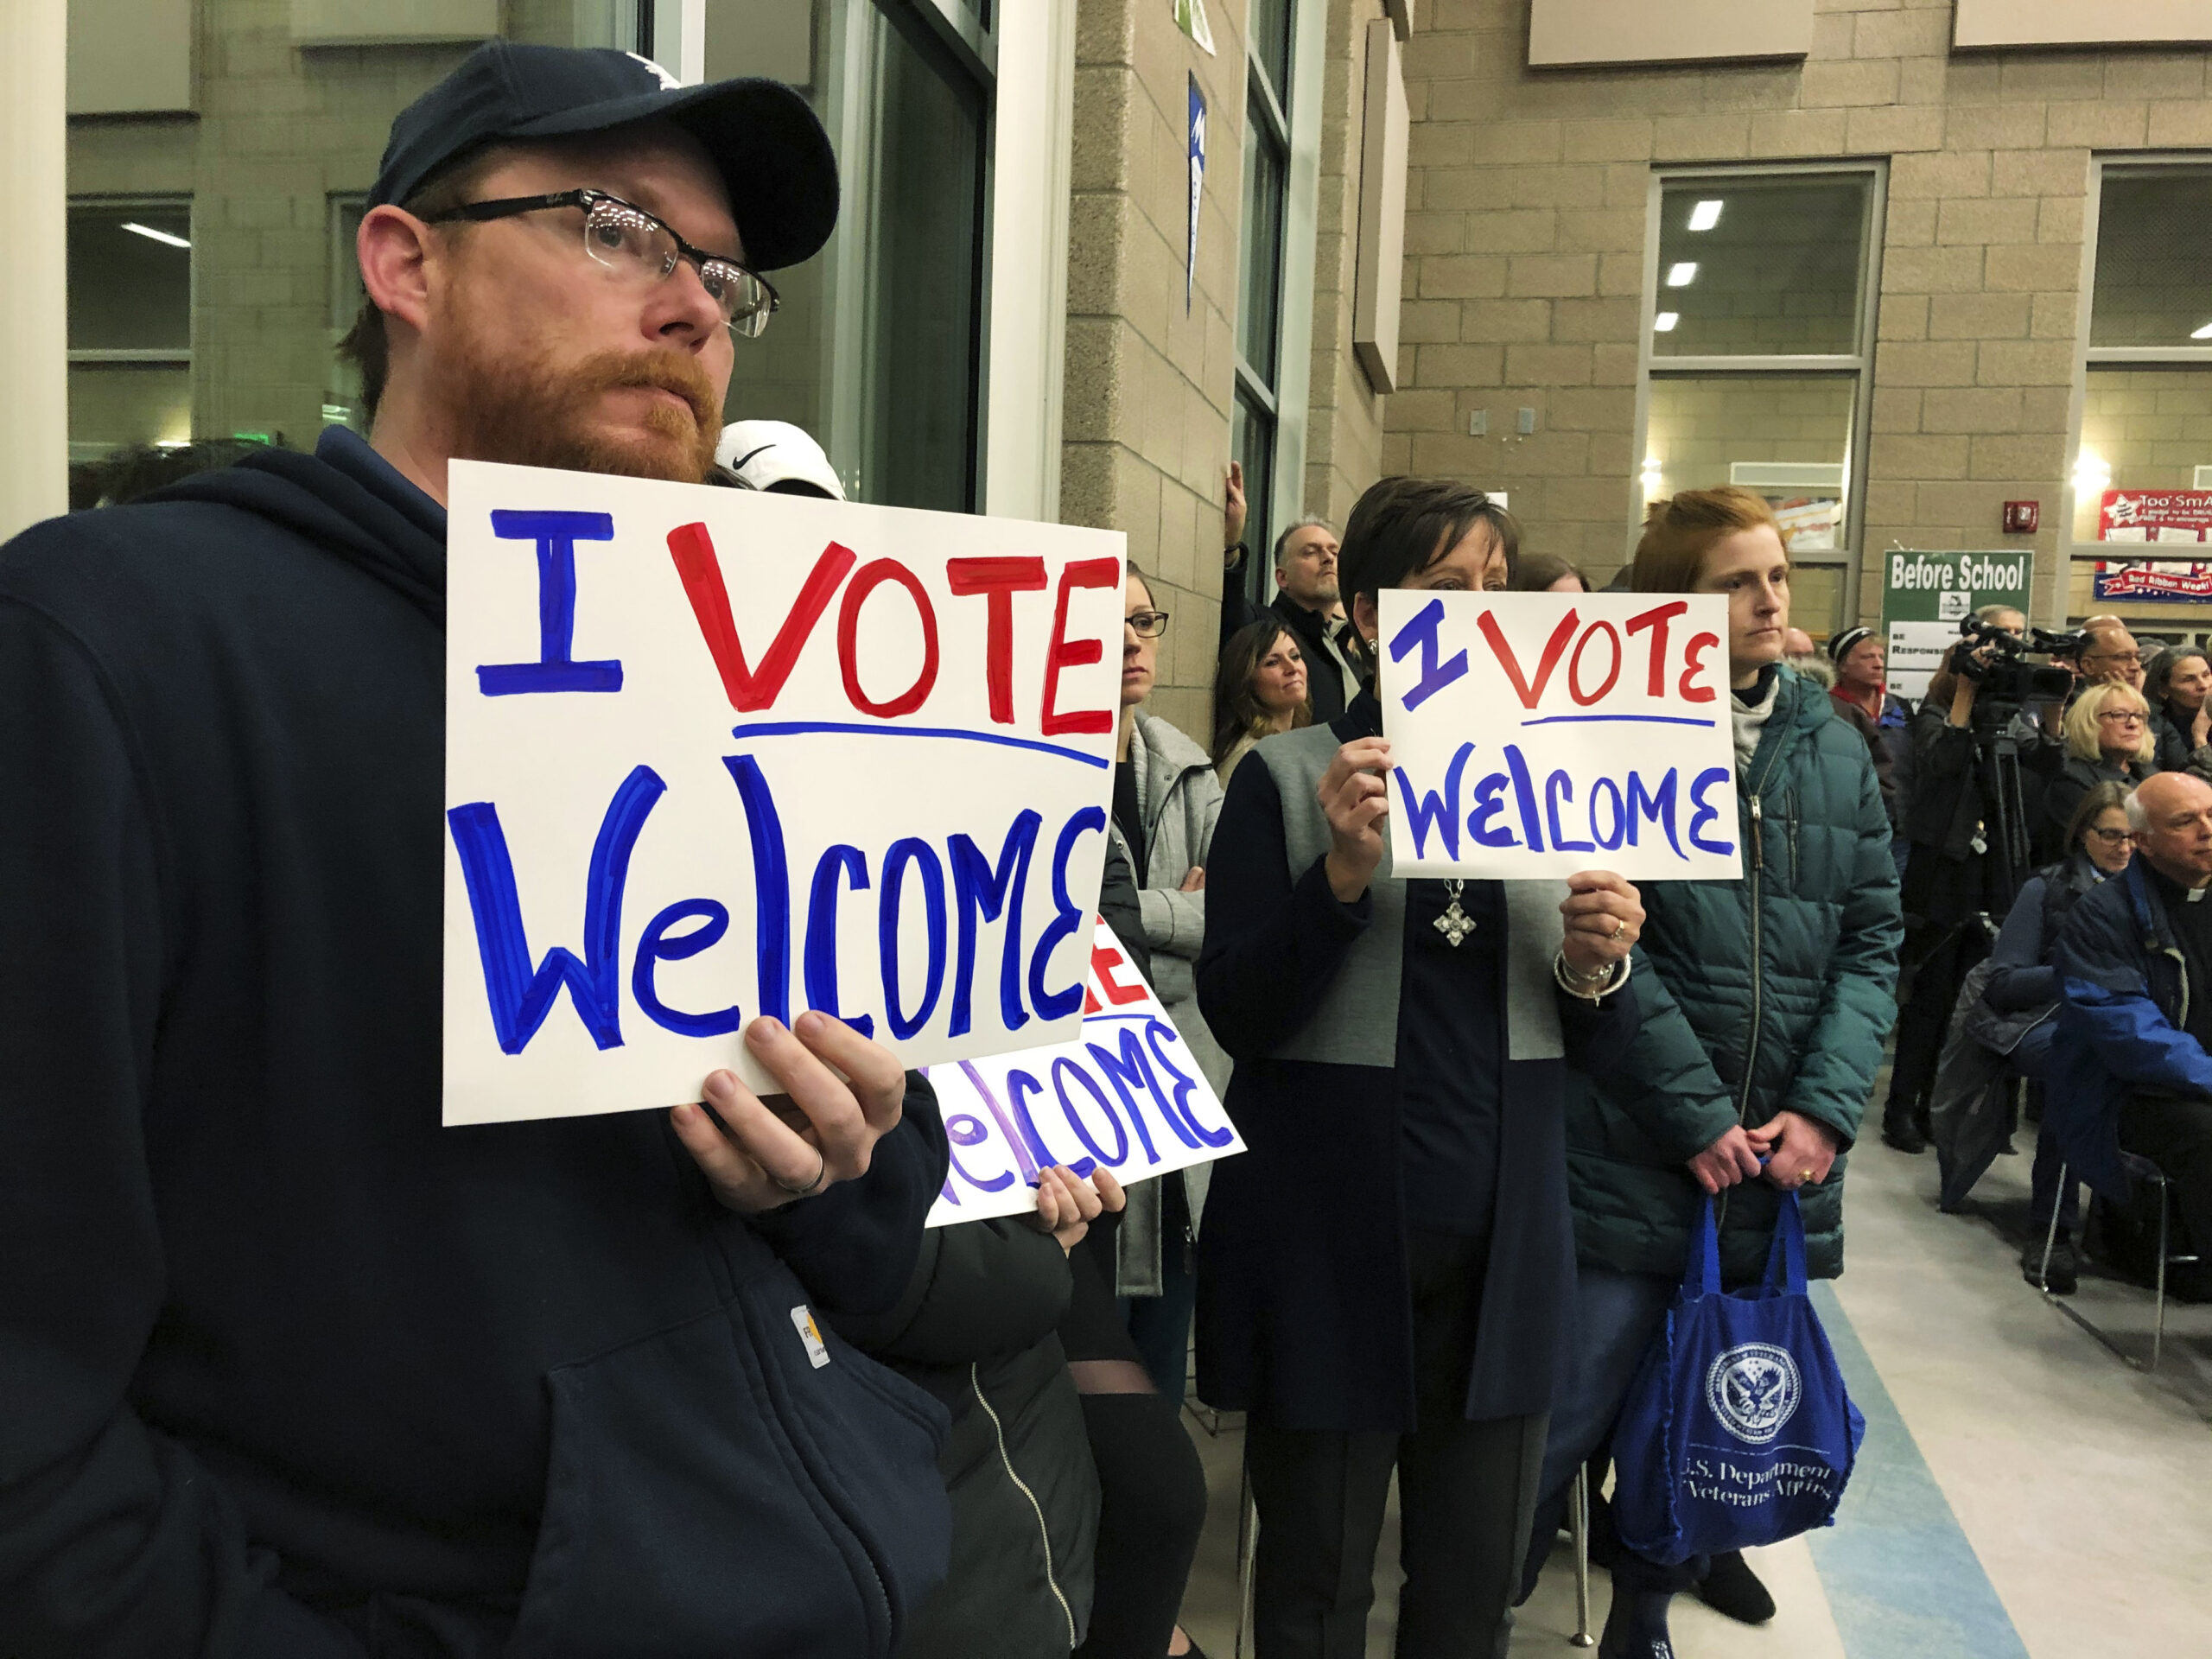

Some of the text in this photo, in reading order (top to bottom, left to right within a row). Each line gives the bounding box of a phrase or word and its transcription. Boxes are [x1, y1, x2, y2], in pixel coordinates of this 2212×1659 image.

[1891, 555, 2024, 590] Before School
[475, 509, 1119, 735] I VOTE
[1389, 599, 1720, 711] I VOTE
[1681, 1479, 1771, 1507] Veterans
[1720, 1462, 1831, 1491] Department
